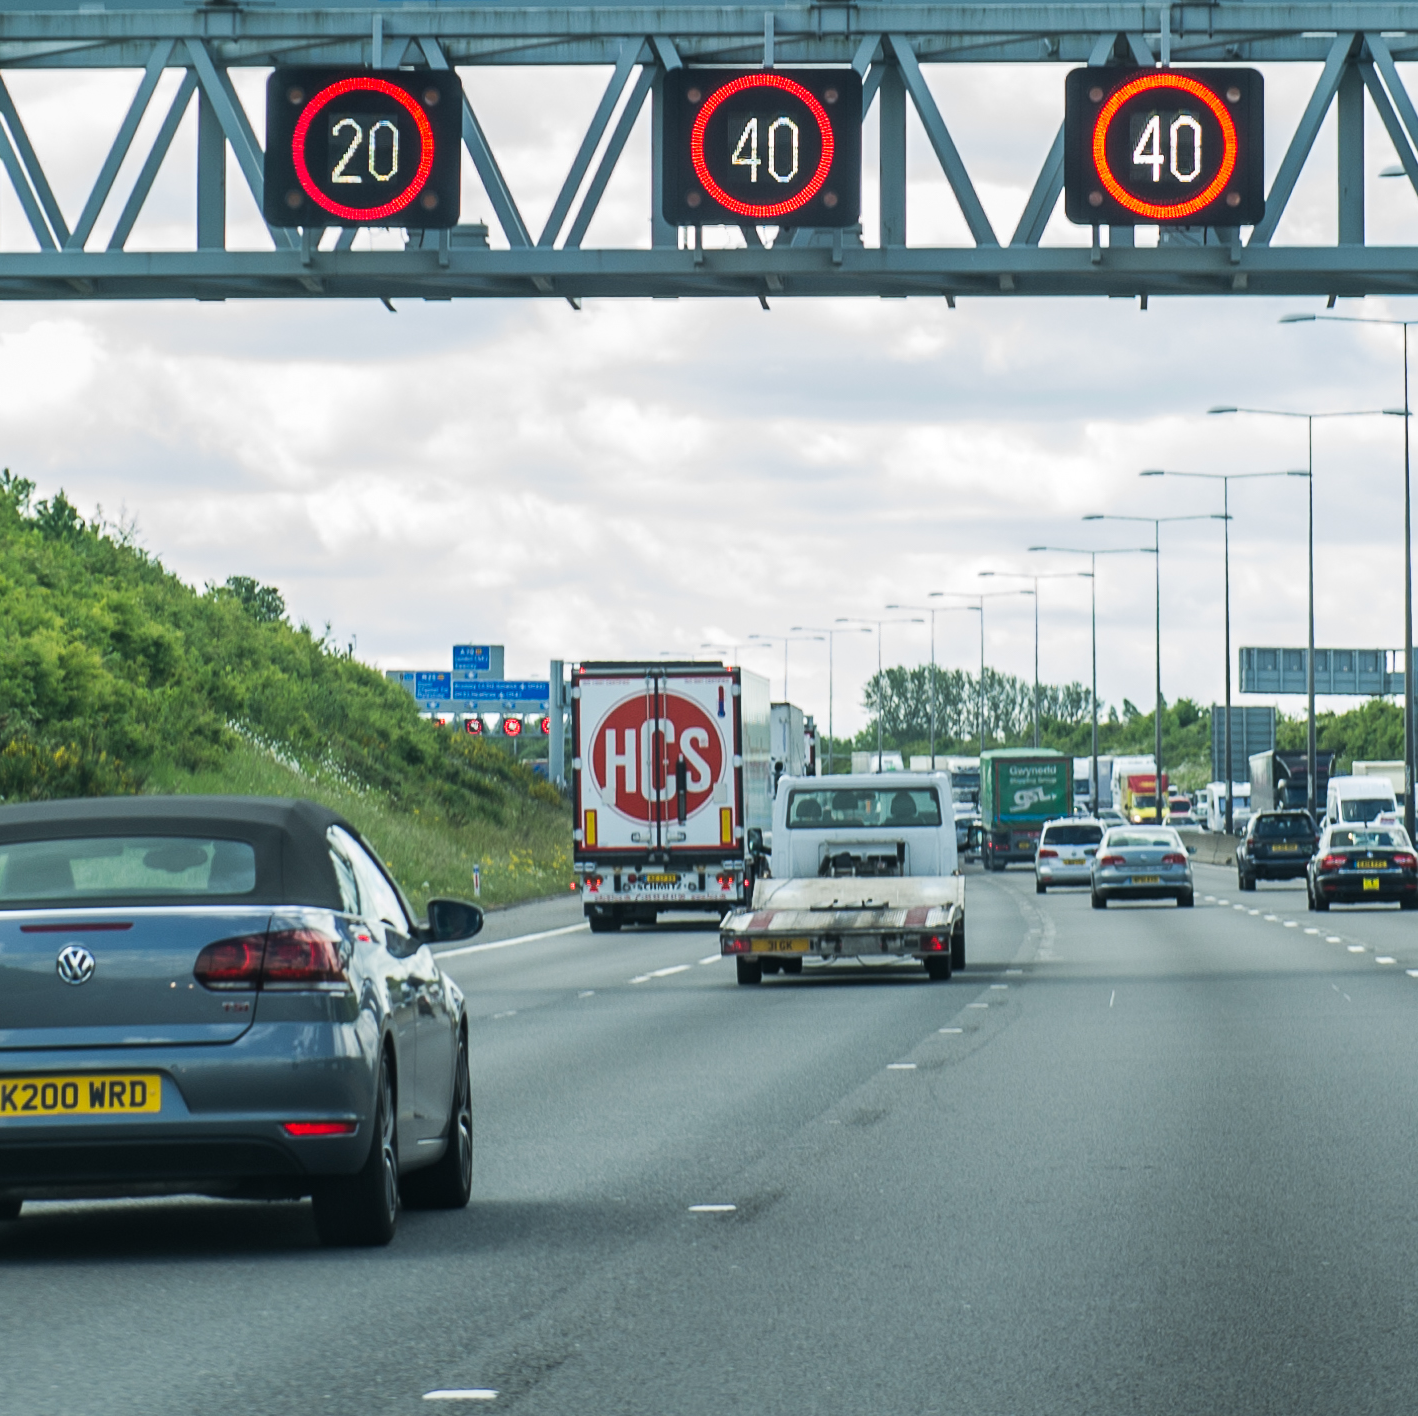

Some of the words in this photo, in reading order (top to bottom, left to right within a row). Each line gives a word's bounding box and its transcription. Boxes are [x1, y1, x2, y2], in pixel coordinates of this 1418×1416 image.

[329, 118, 399, 184] 20
[730, 117, 800, 183] 40
[1132, 116, 1202, 182] 40
[605, 718, 711, 802] HCS
[1009, 765, 1057, 777] Gwynedd
[0, 1082, 79, 1111] K200
[88, 1078, 148, 1109] WRD
